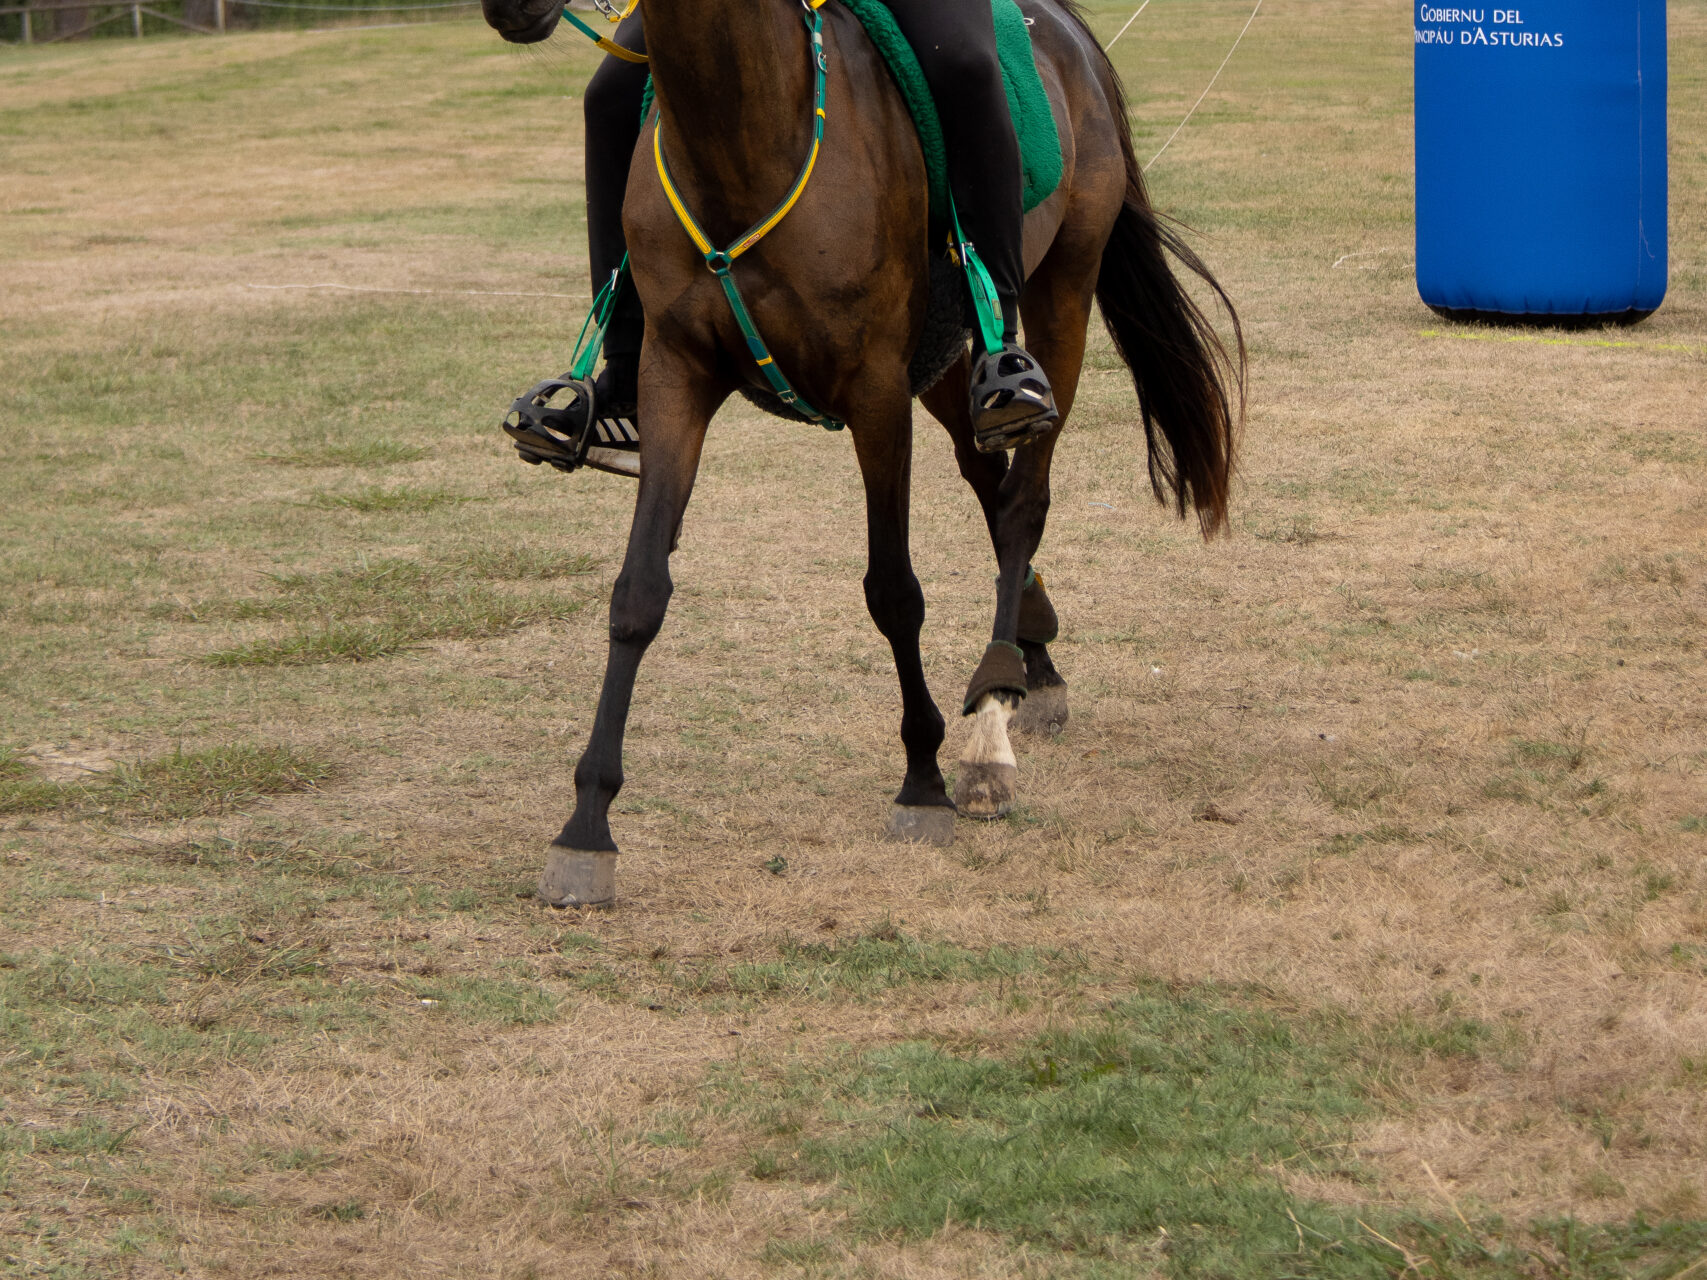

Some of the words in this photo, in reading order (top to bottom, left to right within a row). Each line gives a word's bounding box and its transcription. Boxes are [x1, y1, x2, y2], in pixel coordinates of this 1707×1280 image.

[1420, 3, 1484, 23] GOBIERNU
[1493, 9, 1524, 24] DEL
[1460, 26, 1564, 47] D'ASTURIAS
